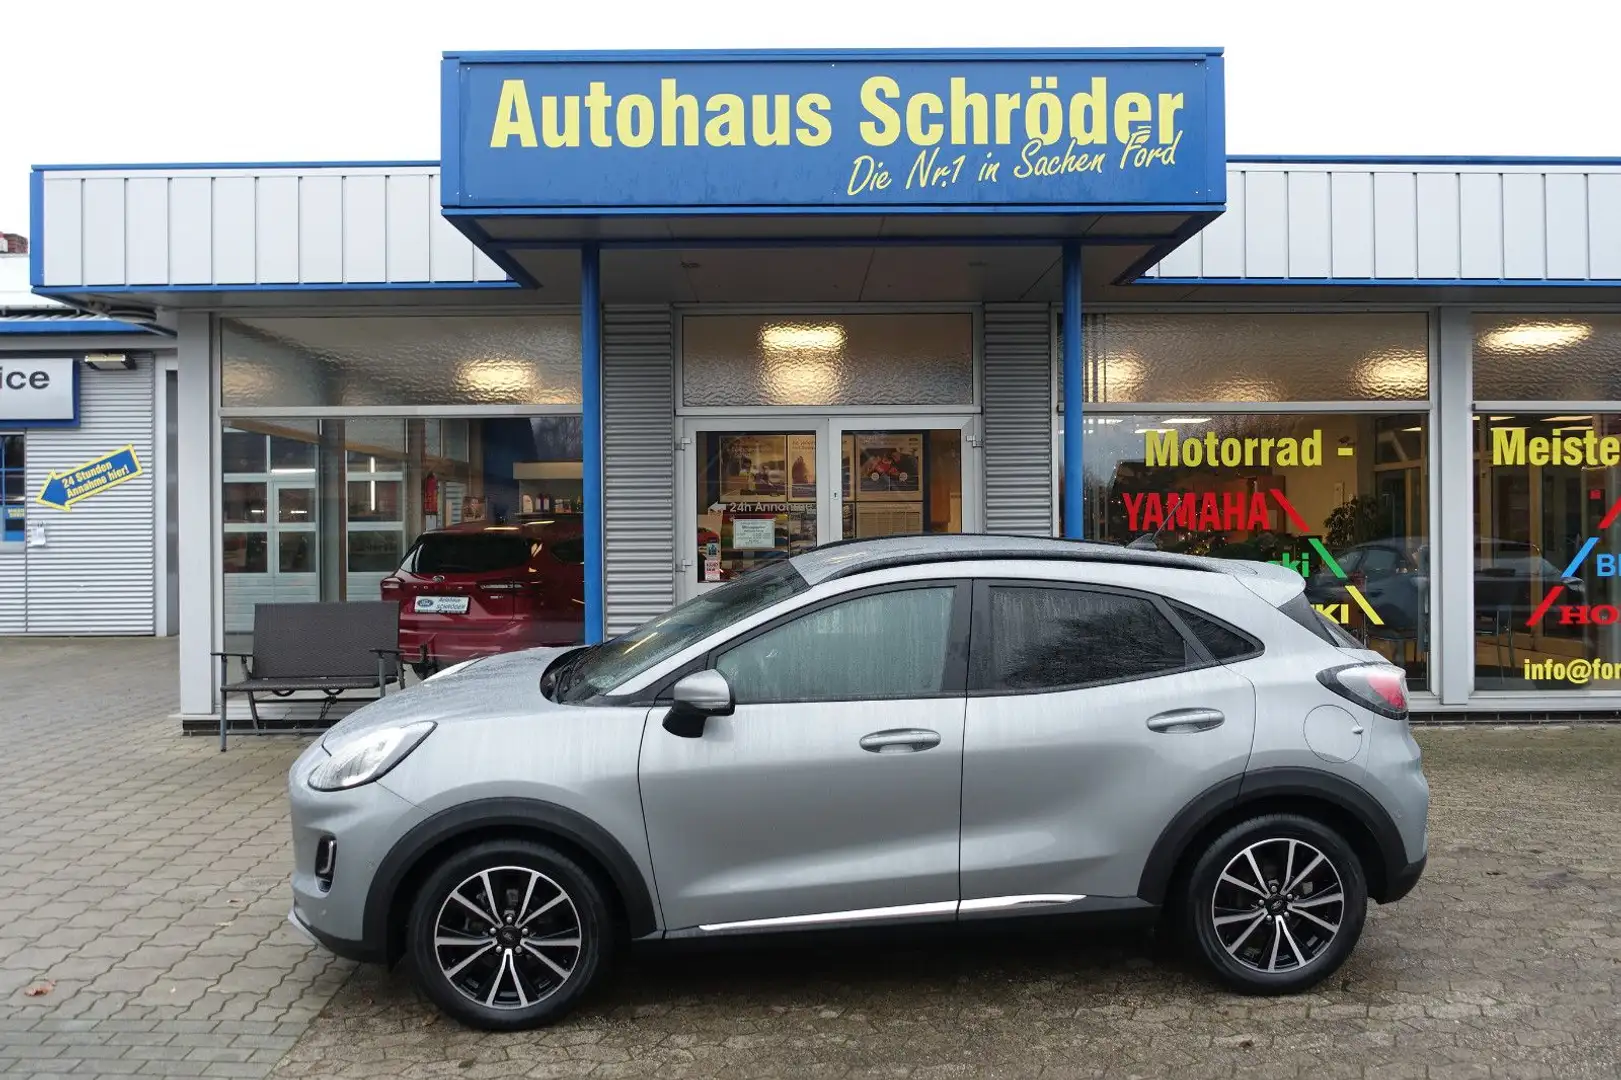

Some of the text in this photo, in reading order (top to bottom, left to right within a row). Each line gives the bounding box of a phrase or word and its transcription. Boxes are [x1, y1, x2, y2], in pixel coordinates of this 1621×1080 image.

[490, 76, 1184, 148] Autohaus Schröder
[847, 126, 1183, 195] Die Nr.1 in Sachen Ford
[1145, 429, 1322, 467] Motorrad
[1492, 427, 1620, 467] Meiste
[62, 461, 113, 489] 24 Stunden
[730, 502, 752, 512] 24h
[1122, 491, 1270, 531] YAMAHA
[1267, 552, 1310, 577] ki
[1597, 553, 1621, 577] B
[1310, 604, 1349, 624] KI
[1559, 604, 1621, 625] HO
